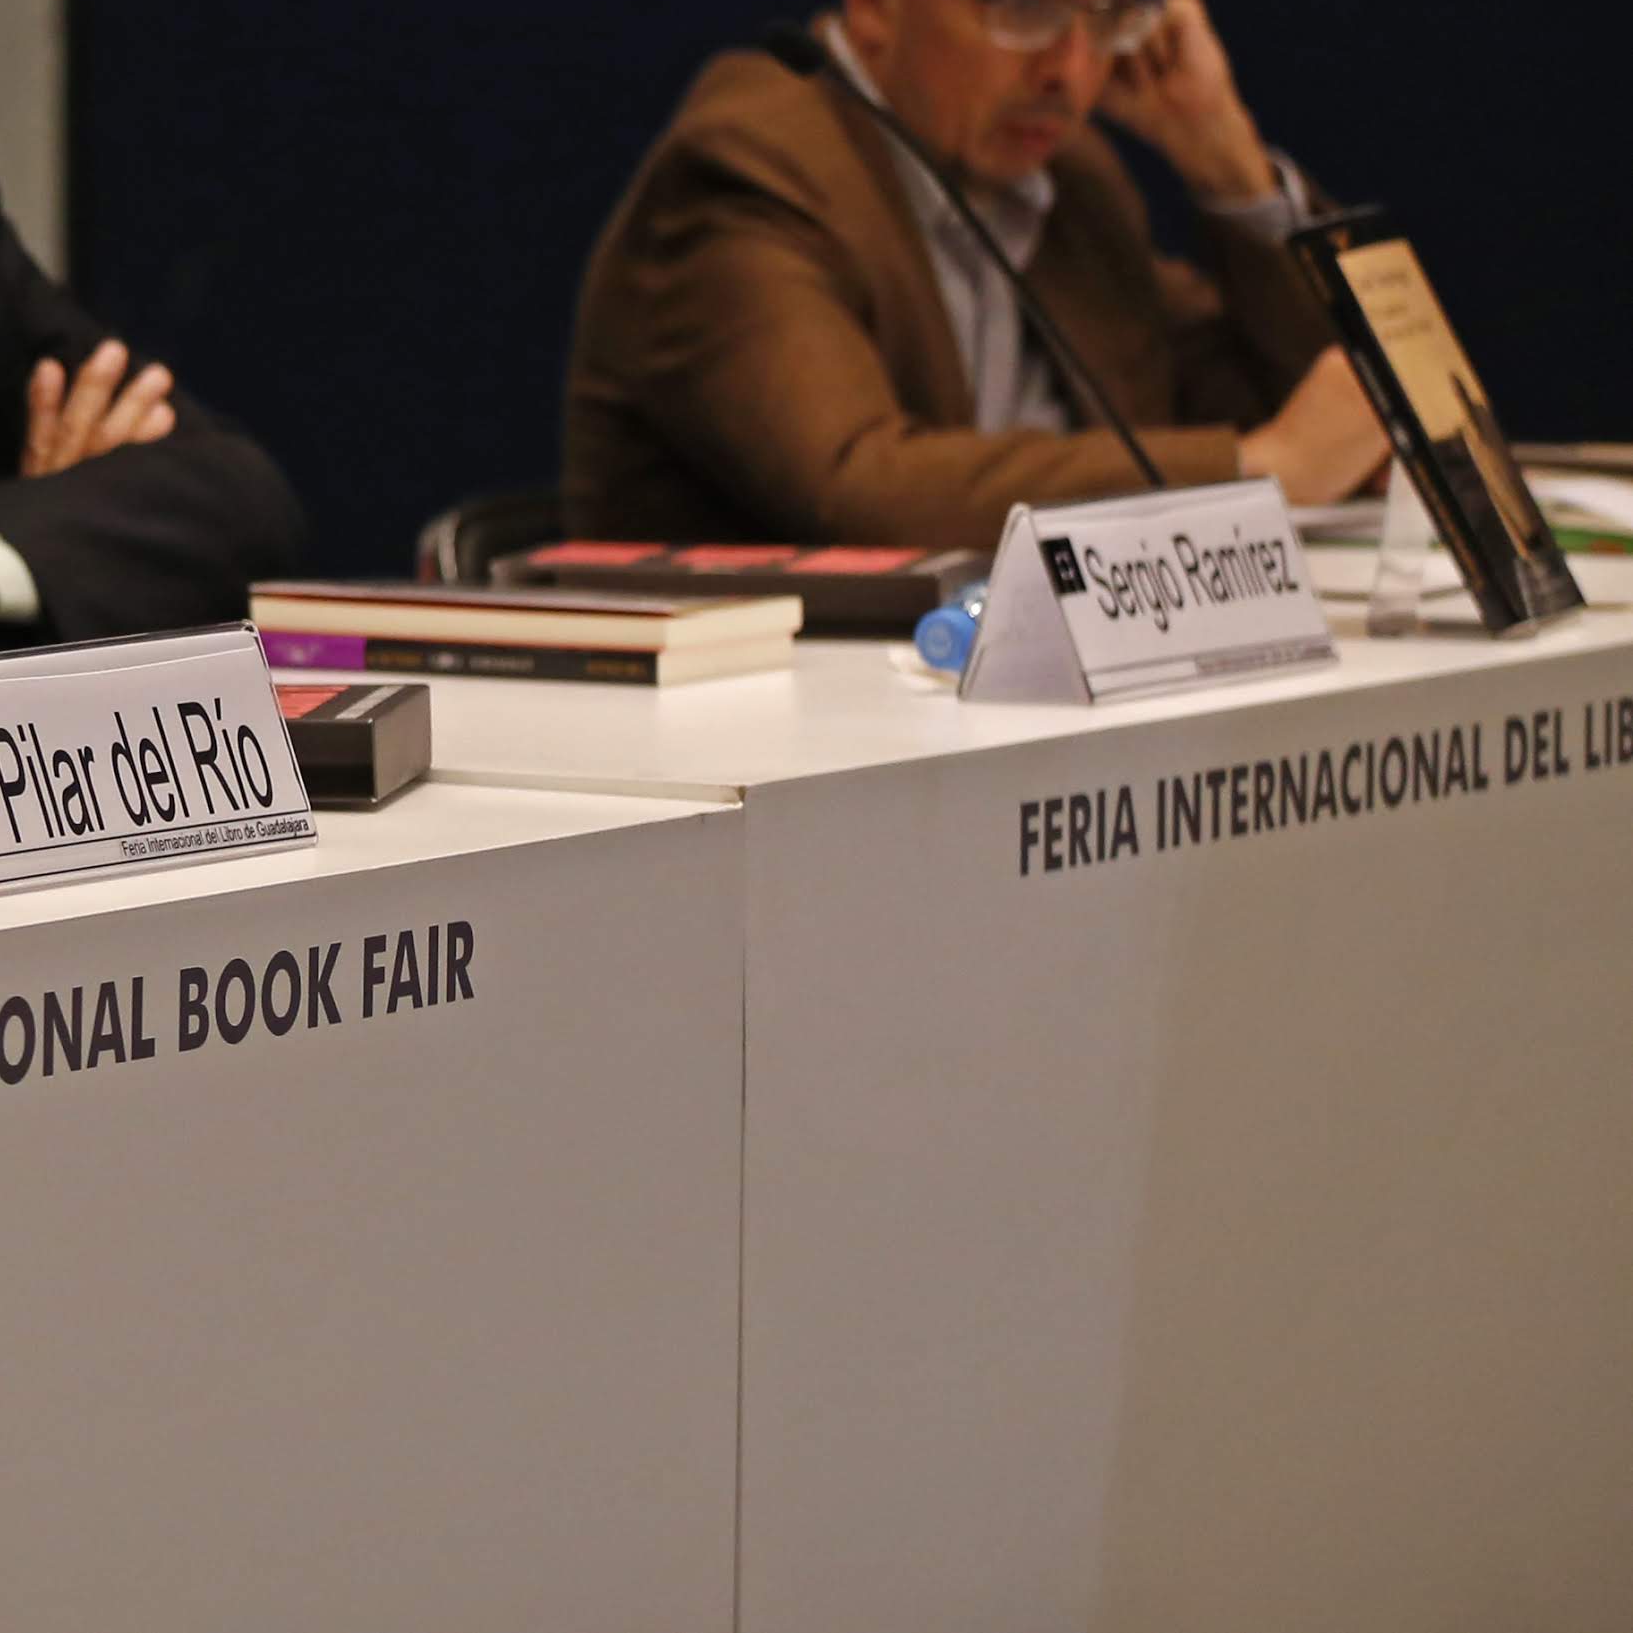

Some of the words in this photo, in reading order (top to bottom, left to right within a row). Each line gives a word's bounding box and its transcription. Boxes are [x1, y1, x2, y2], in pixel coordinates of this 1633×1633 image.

[1084, 542, 1184, 632] Sergio
[112, 706, 189, 826] del
[177, 697, 275, 814] Río
[1018, 784, 1139, 877] FERIA
[1155, 723, 1488, 851] INTERNACIONAL
[1503, 708, 1570, 783] DEL
[121, 839, 147, 857] Feria
[147, 830, 204, 853] Internacional
[206, 831, 220, 845] del
[220, 826, 243, 842] Libro
[244, 824, 256, 838] de
[256, 817, 309, 837] Guadalajara
[177, 940, 342, 1054] BOOK
[361, 920, 475, 1020] FAIR
